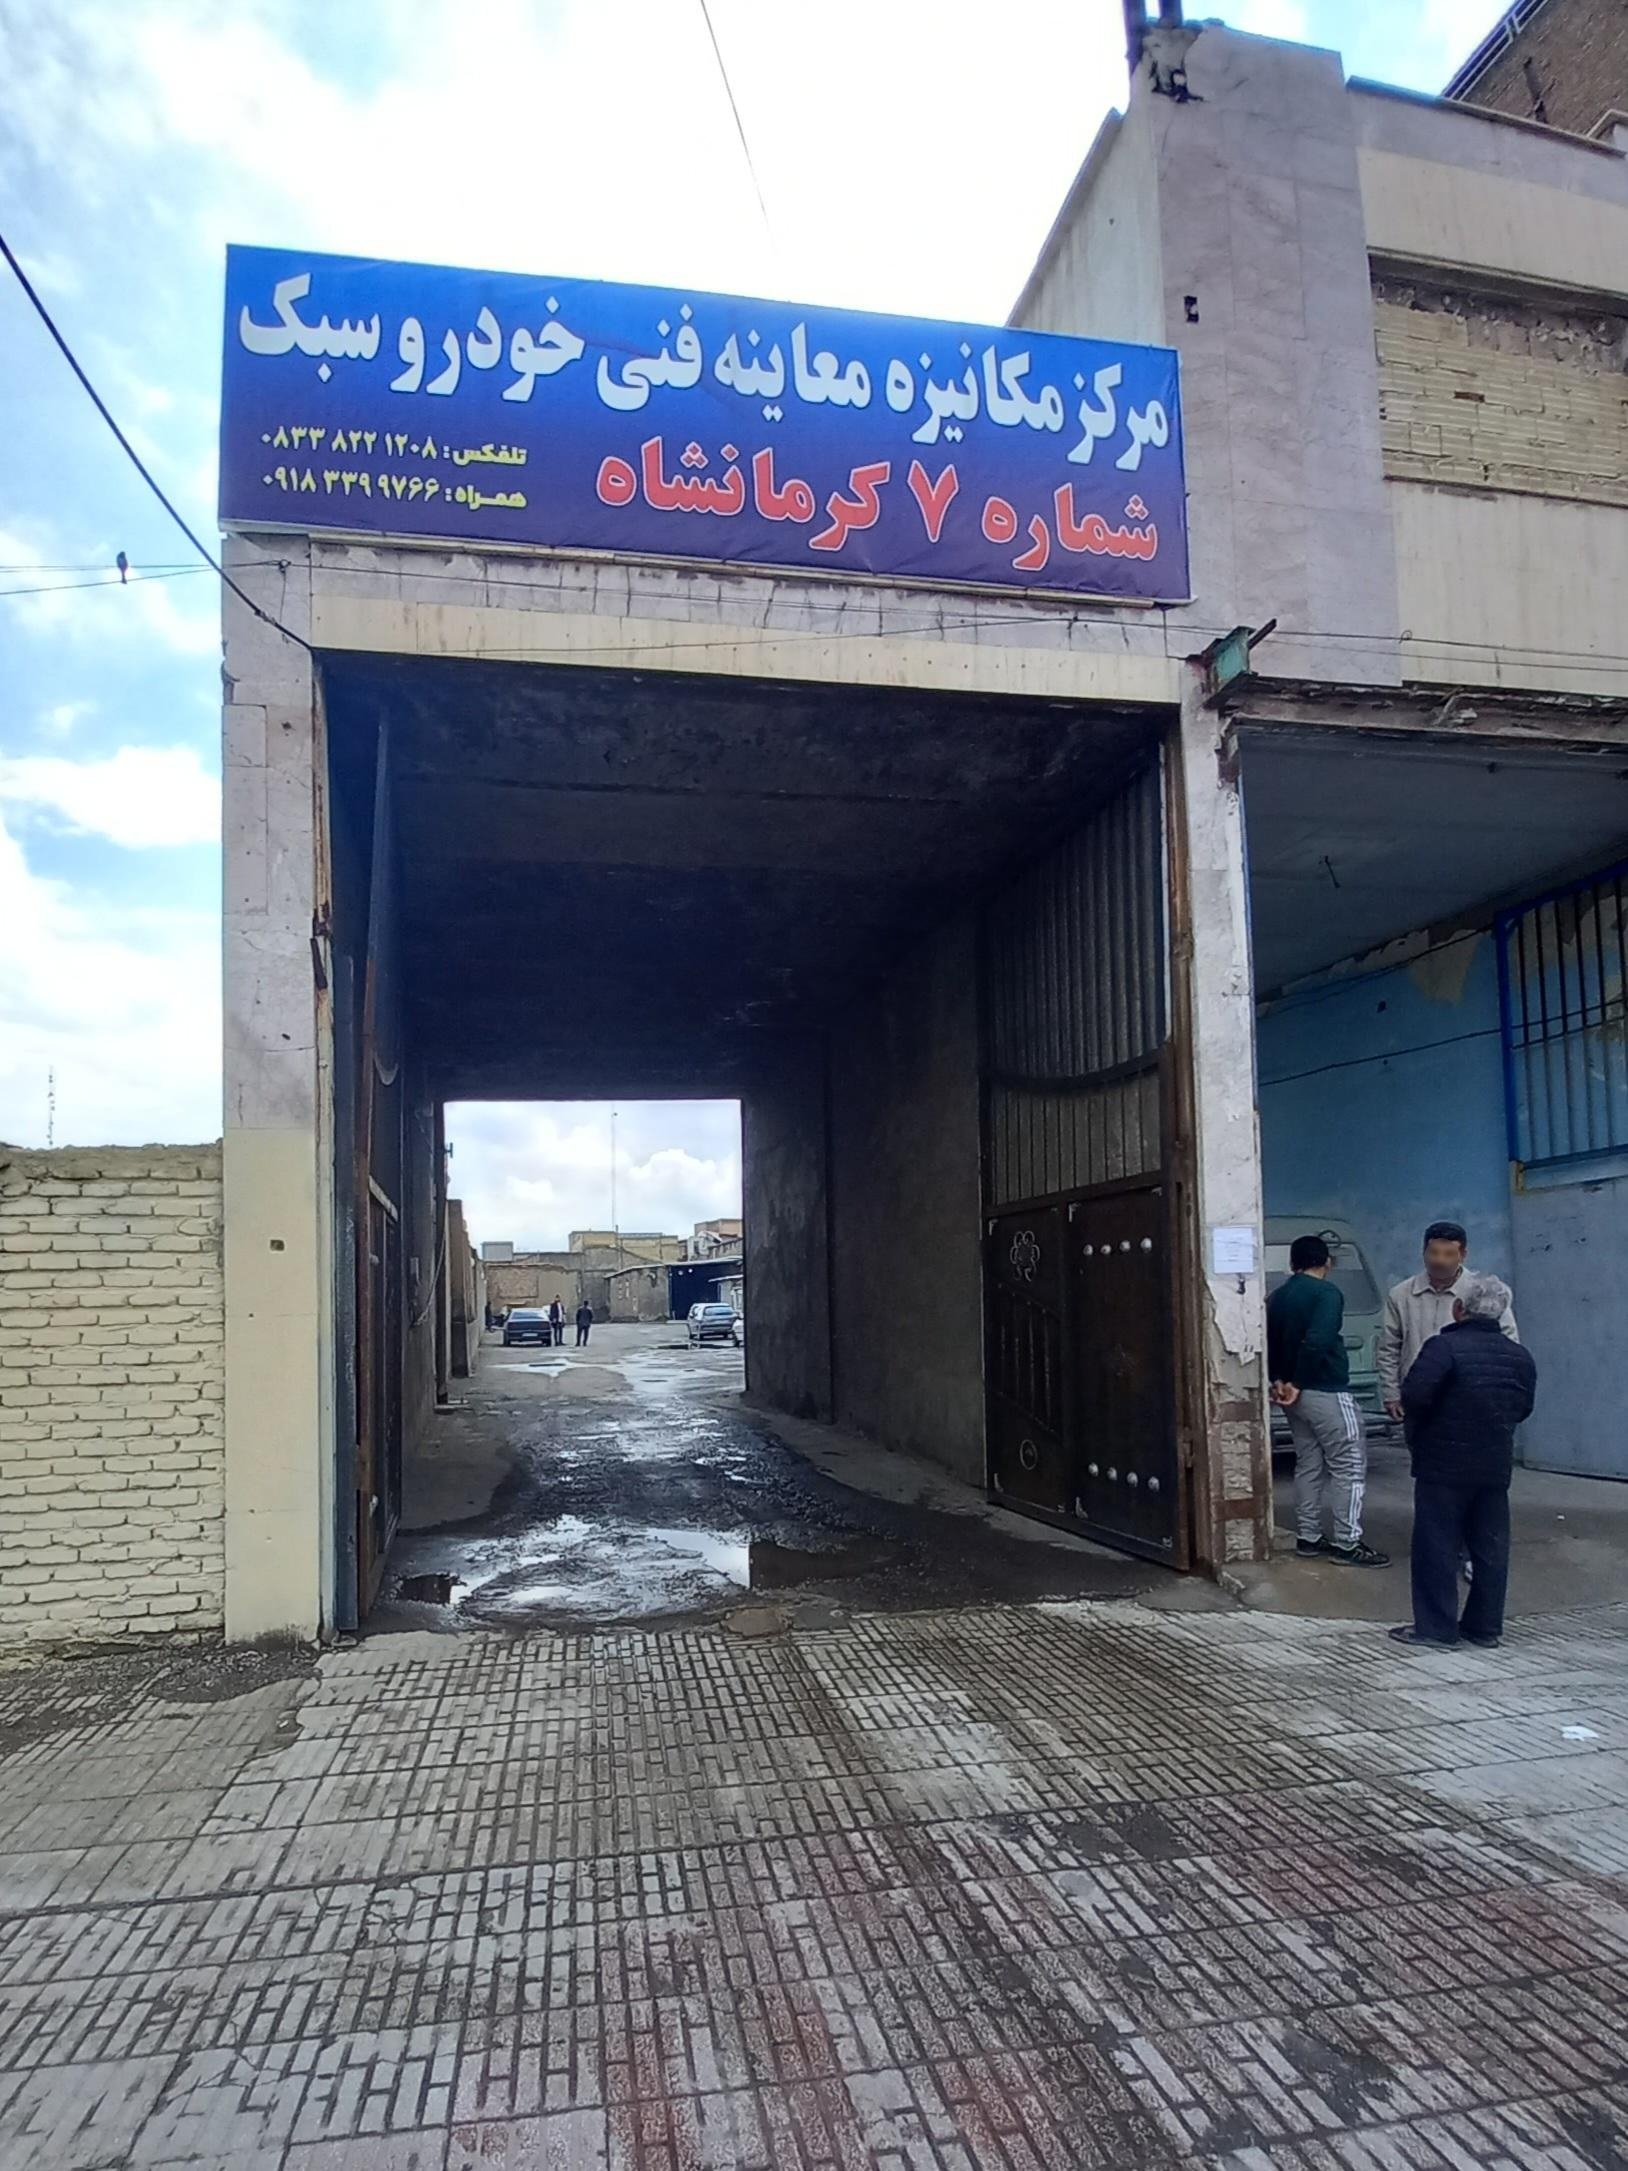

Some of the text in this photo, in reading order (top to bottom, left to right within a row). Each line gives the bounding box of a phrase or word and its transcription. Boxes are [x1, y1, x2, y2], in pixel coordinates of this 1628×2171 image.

[240, 273, 1169, 471] مرکز مکانیزه معاینه فنی خودرو سبک
[261, 426, 326, 450] ۰۸۳۳
[331, 429, 377, 454] ۸۲۲
[385, 432, 437, 459] ۱۲۰۸
[262, 466, 316, 492] ۰۹۱۸
[323, 469, 371, 498] ۳۳۹
[378, 473, 440, 502] ۹۷۶۶
[596, 435, 1159, 571] شماره ۷ کرمانشاه
